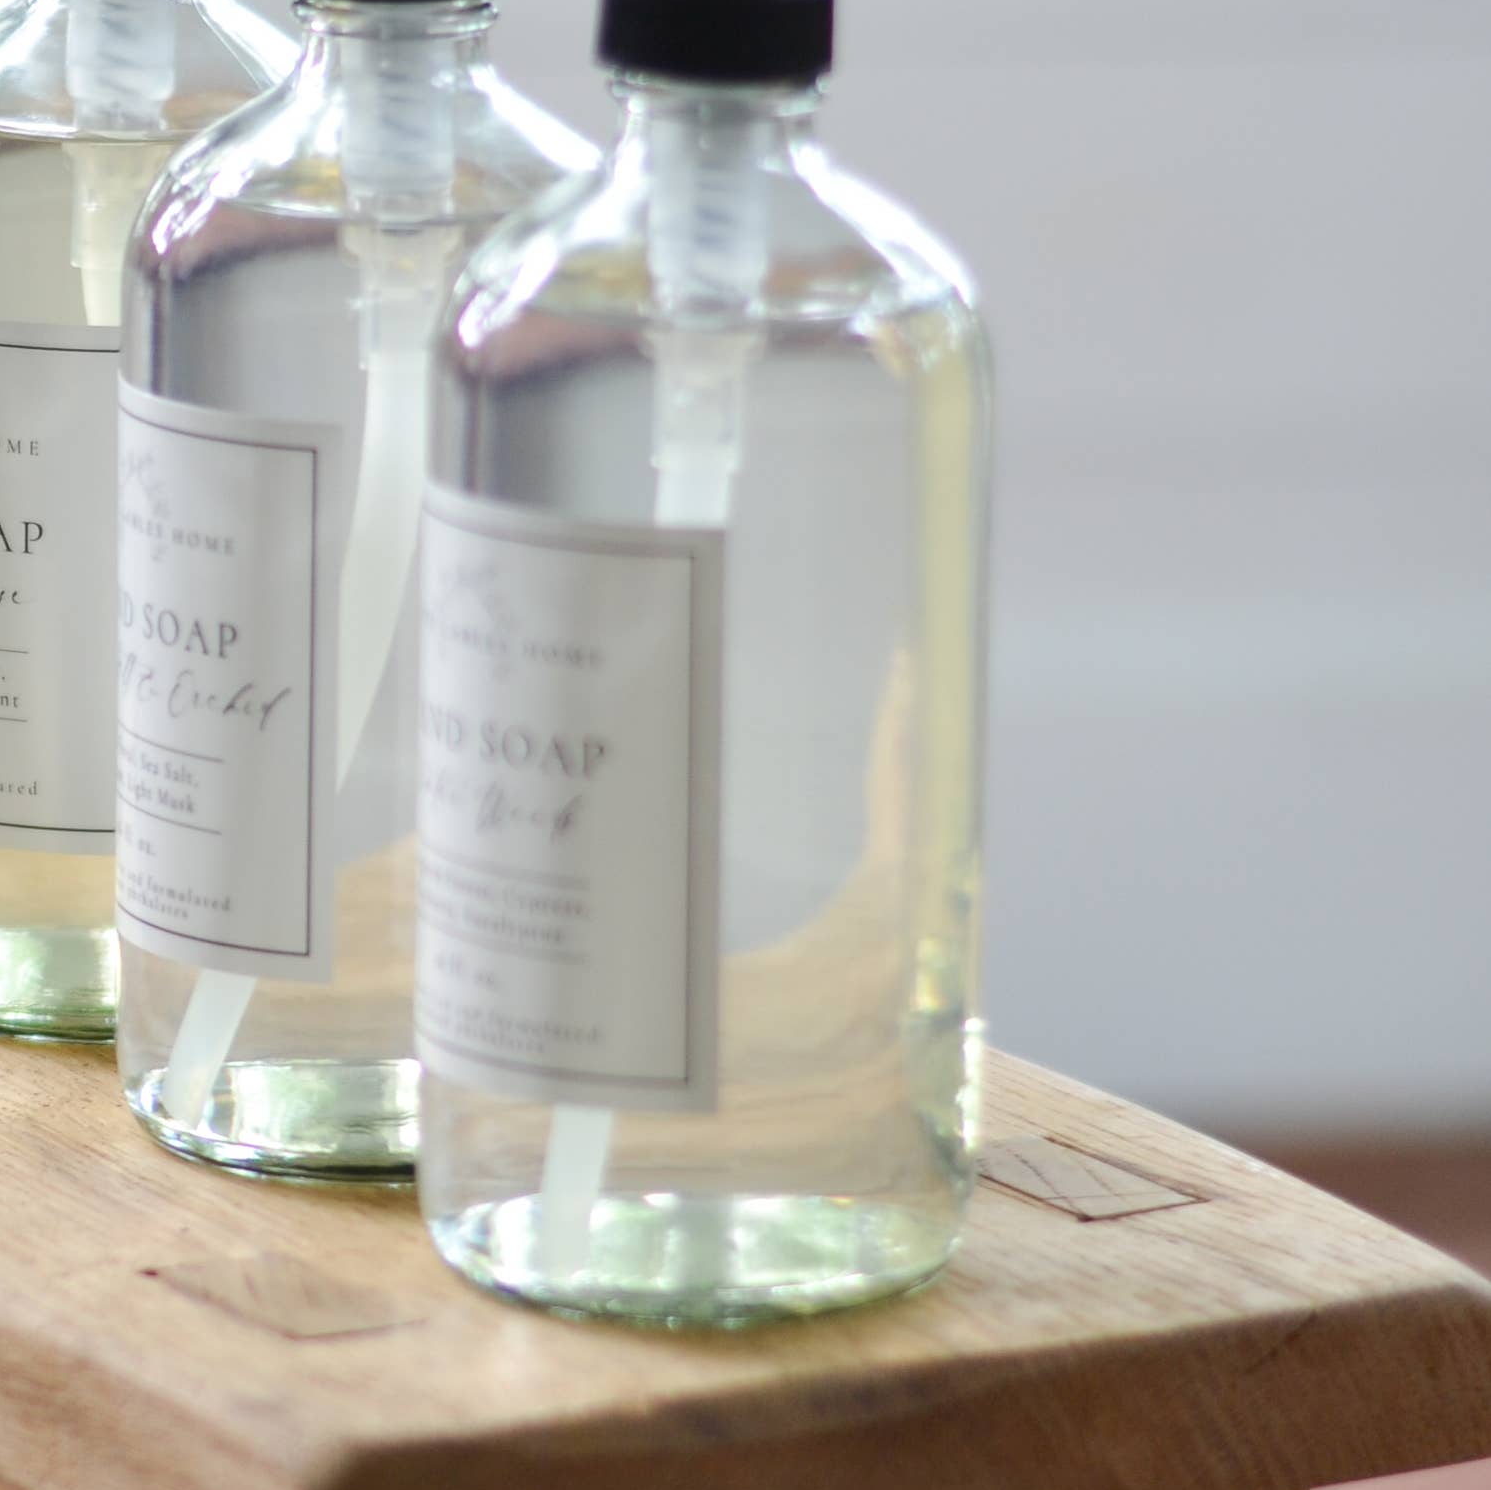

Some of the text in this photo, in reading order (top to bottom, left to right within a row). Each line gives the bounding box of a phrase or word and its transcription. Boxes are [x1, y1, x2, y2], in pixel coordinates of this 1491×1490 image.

[171, 526, 236, 557] HOME
[142, 602, 239, 659] SOAP
[479, 718, 610, 782] SOAP
